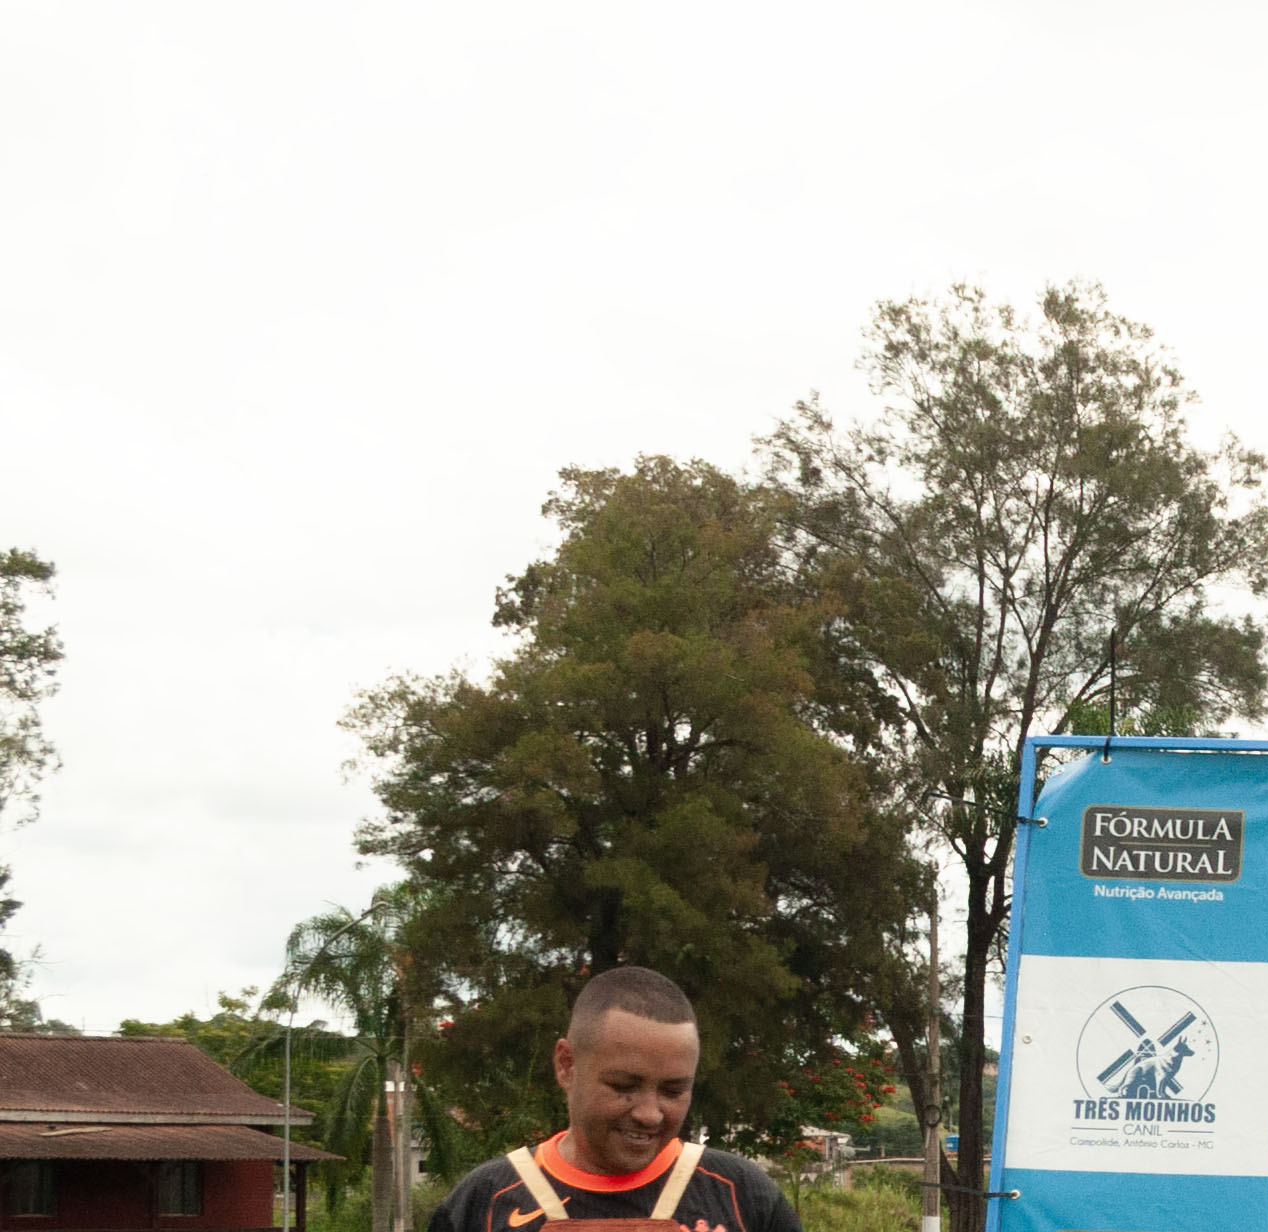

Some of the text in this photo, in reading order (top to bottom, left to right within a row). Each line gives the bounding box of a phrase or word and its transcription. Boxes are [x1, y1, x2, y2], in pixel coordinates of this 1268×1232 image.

[1094, 812, 1233, 840] FÓRMULA
[1090, 846, 1232, 874] NATURAL
[1094, 885, 1224, 902] Nutrição Avançada
[1073, 1097, 1216, 1123] TRÊS MOINHOS
[1123, 1124, 1162, 1136] CANIL
